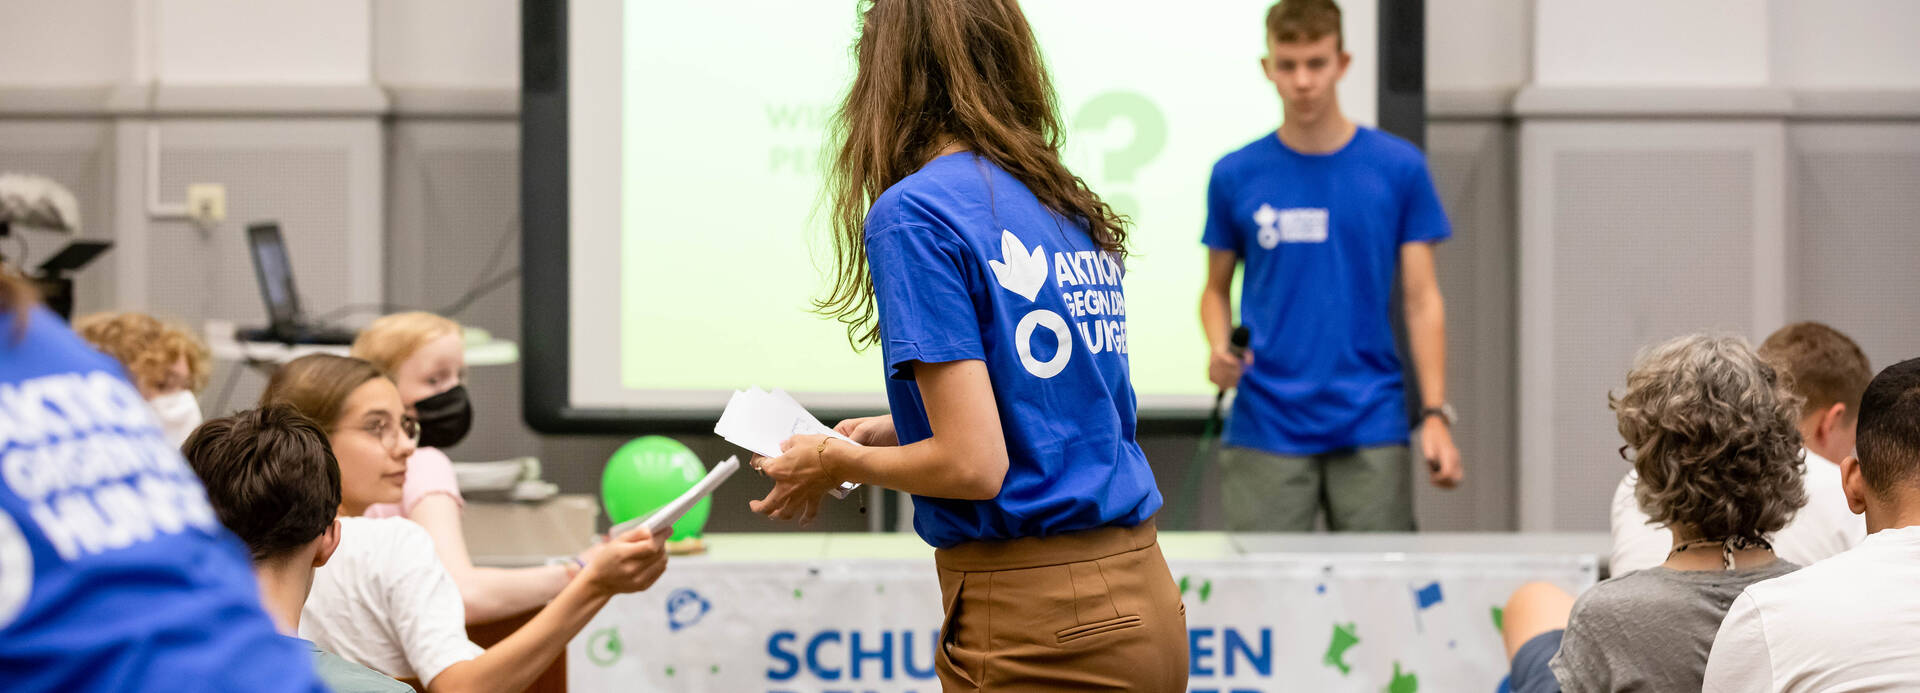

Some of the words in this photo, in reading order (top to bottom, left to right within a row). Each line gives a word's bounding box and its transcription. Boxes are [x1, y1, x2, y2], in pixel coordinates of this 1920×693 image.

[1054, 249, 1122, 288] AKTION
[1076, 319, 1128, 354] UNGE
[766, 630, 940, 681] SCHU
[1188, 628, 1272, 677] EN
